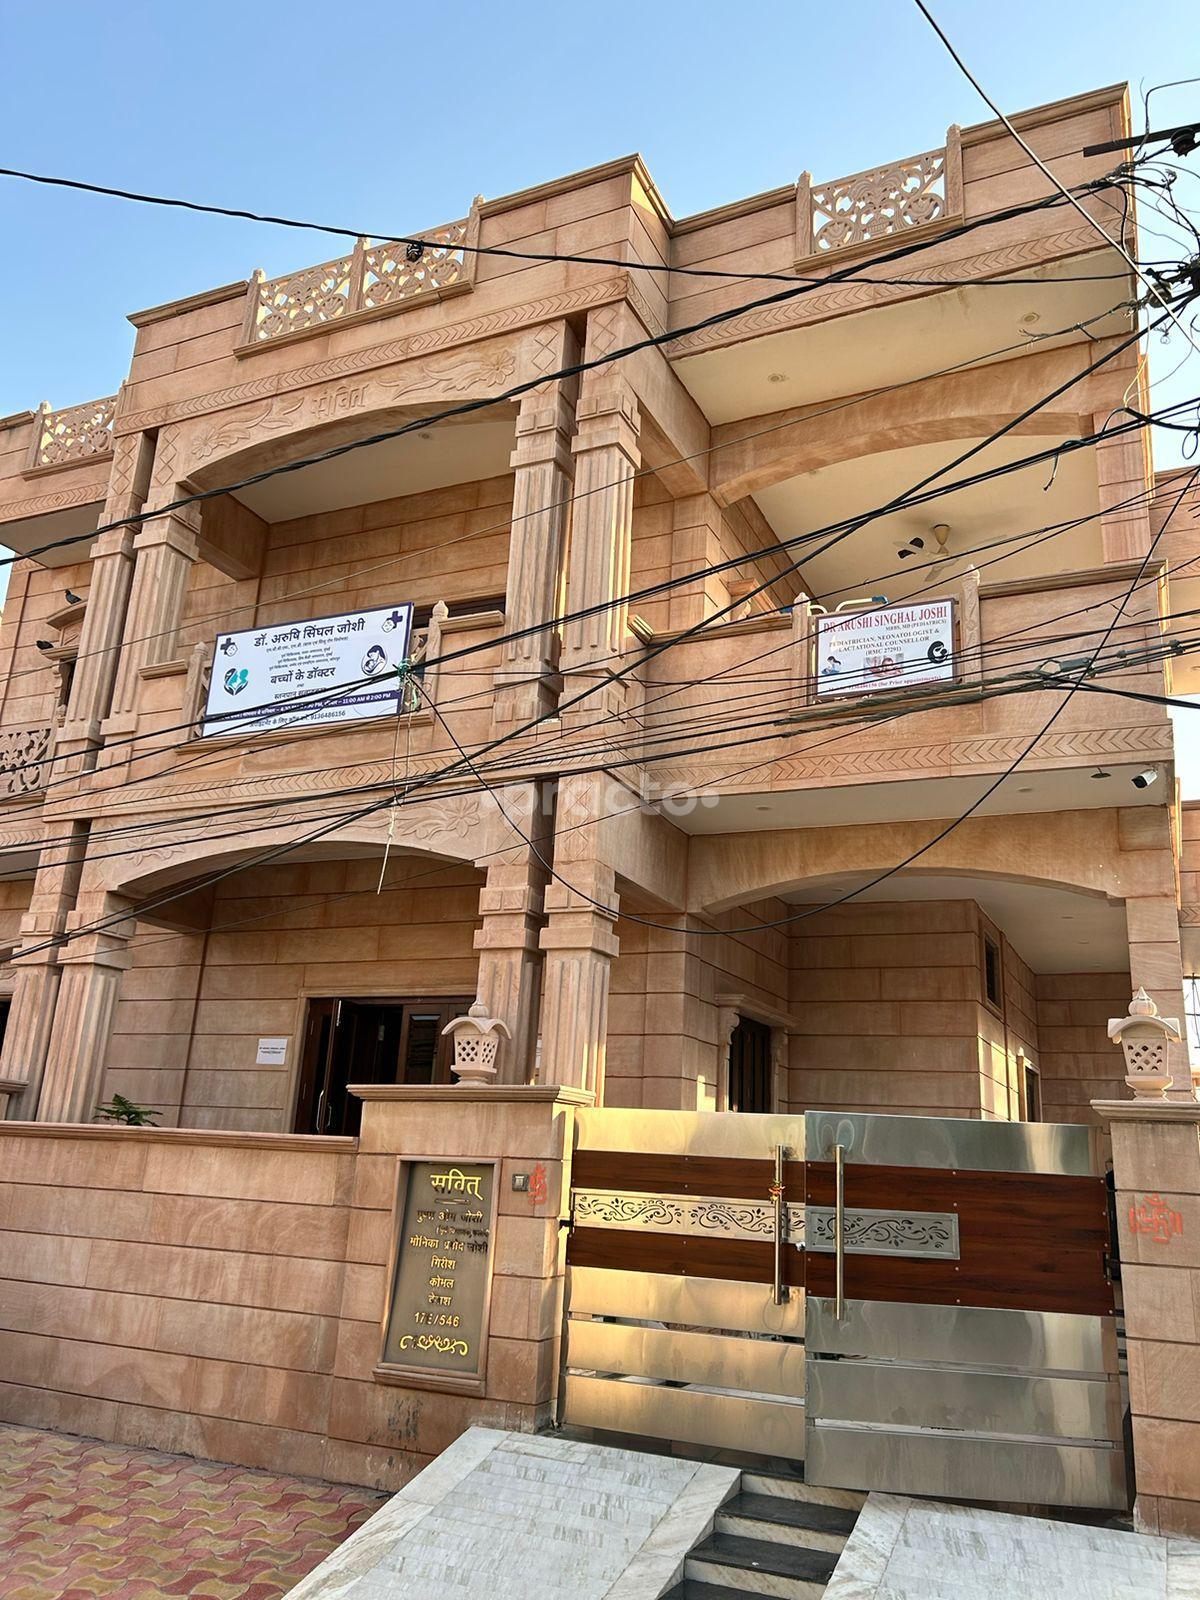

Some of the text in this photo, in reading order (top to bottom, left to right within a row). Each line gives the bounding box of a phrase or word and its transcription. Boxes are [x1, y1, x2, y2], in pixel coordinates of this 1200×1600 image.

[837, 616, 871, 631] ARUSHI
[874, 610, 915, 626] SINGHAL
[919, 606, 946, 620] JOSHI
[253, 617, 365, 647] डॉ. अरुषि सिंघल जोशी
[878, 629, 932, 640] NEONATOLOGIST
[838, 635, 929, 652] LACTATIONAL COUNSELLOR
[270, 664, 335, 684] बच्चों के डॉक्टर
[460, 1210, 483, 1222] जोशी
[409, 1235, 439, 1248] मोनिका
[431, 1256, 456, 1269] गिरीश
[429, 1276, 454, 1288] कोमल
